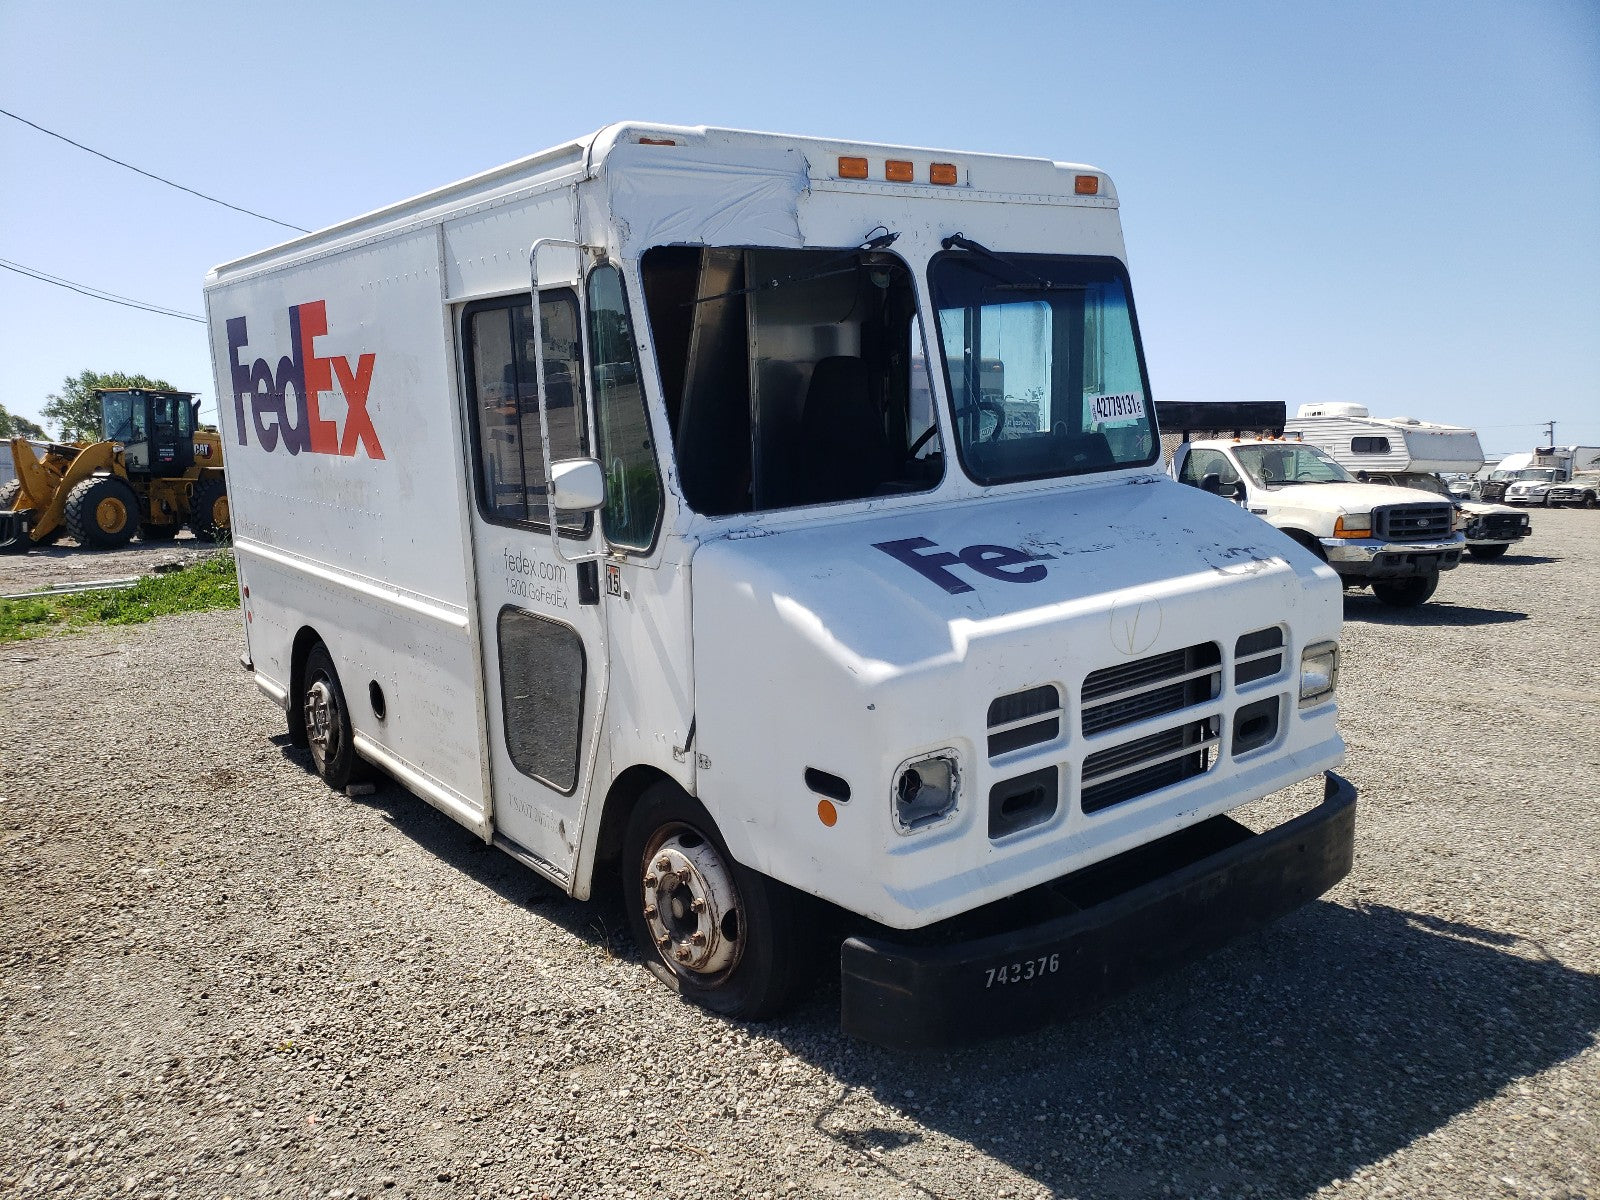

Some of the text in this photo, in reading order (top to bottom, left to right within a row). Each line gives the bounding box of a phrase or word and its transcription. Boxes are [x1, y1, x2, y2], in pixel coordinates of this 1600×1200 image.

[226, 299, 386, 460] FedEx
[1096, 395, 1136, 418] 42779131
[193, 443, 209, 455] CAT
[503, 547, 568, 585] fedex.com
[608, 572, 619, 593] 15
[985, 953, 1060, 988] 743376
